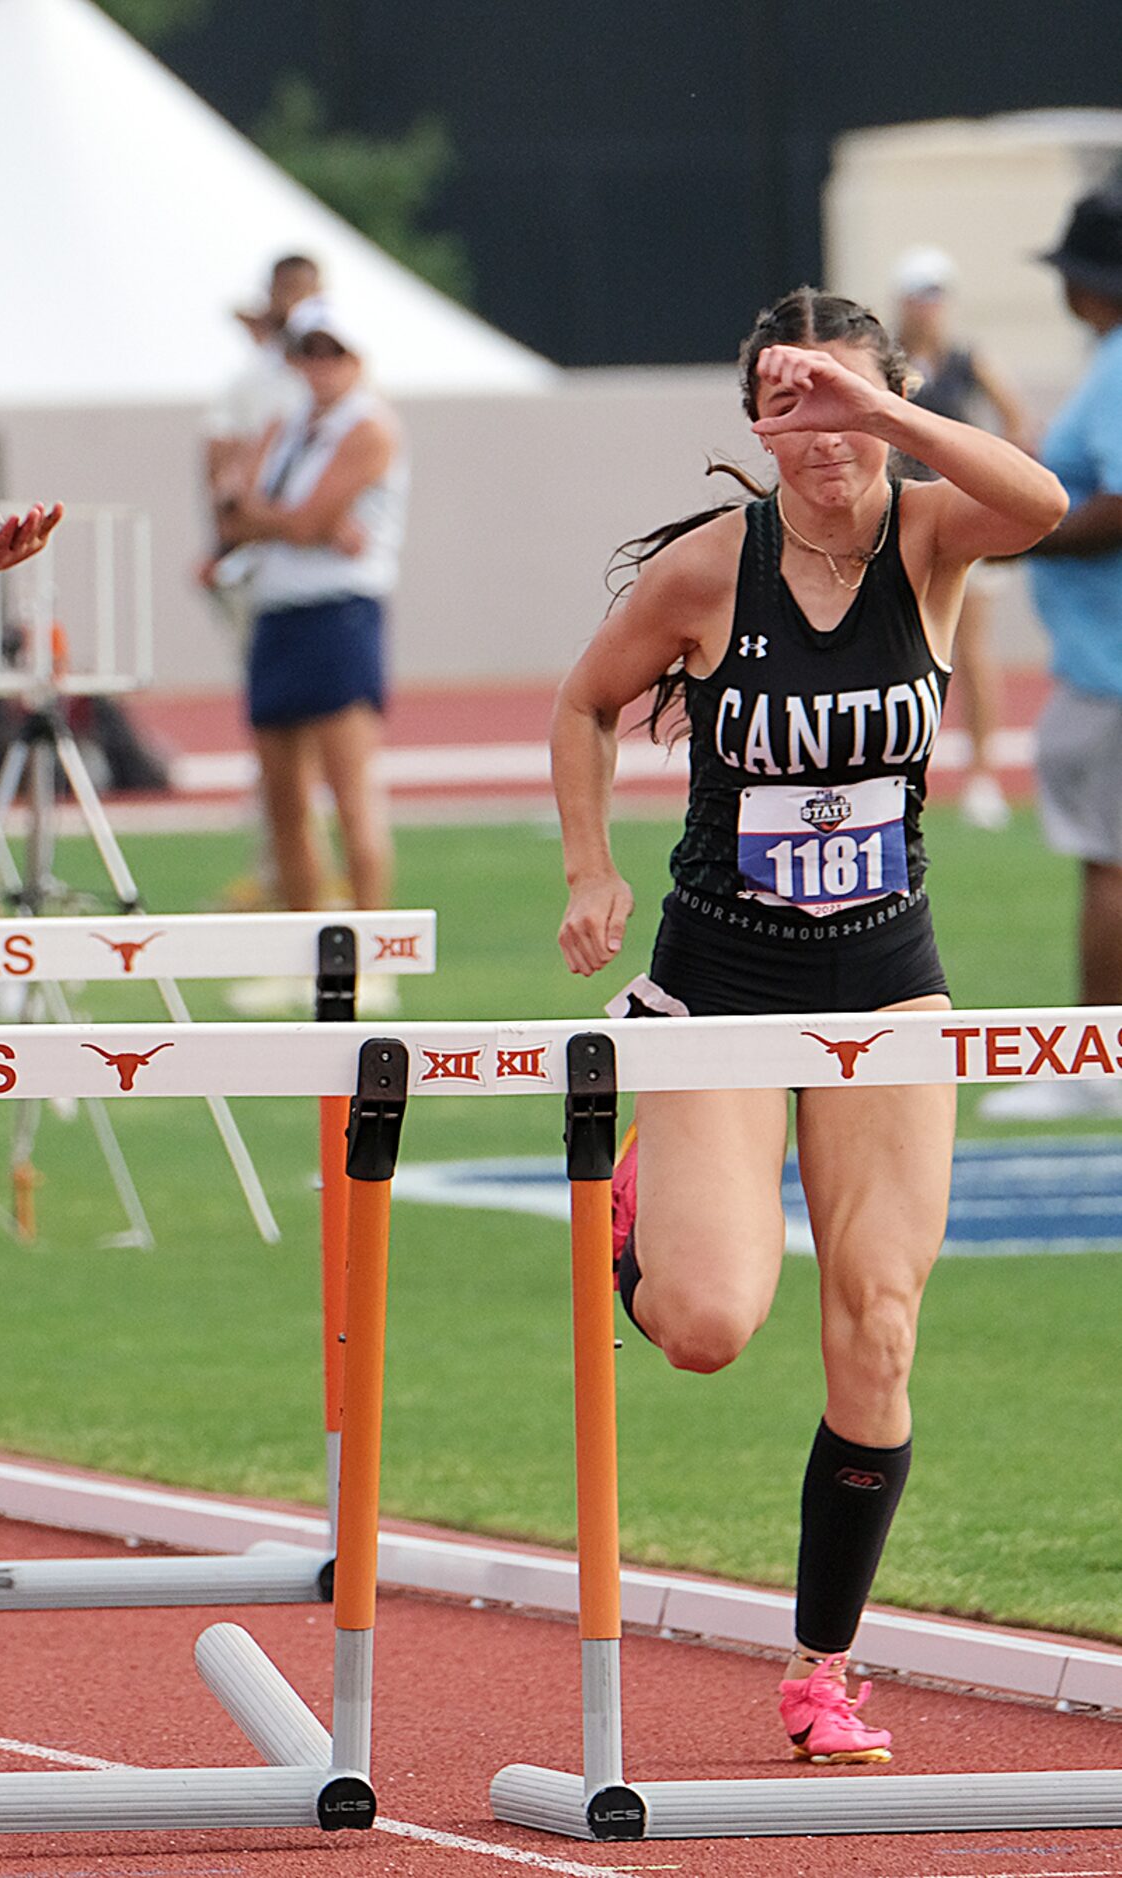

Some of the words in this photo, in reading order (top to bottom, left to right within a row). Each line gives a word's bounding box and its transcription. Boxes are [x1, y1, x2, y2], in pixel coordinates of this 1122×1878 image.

[715, 671, 942, 776] CANTON
[802, 804, 851, 820] STATE
[765, 831, 883, 897] 1181
[754, 921, 838, 940] ARMOUR
[940, 1025, 1122, 1077] TEXA
[421, 1050, 482, 1081] XII
[324, 1800, 372, 1813] UCS
[594, 1809, 641, 1822] UCS
